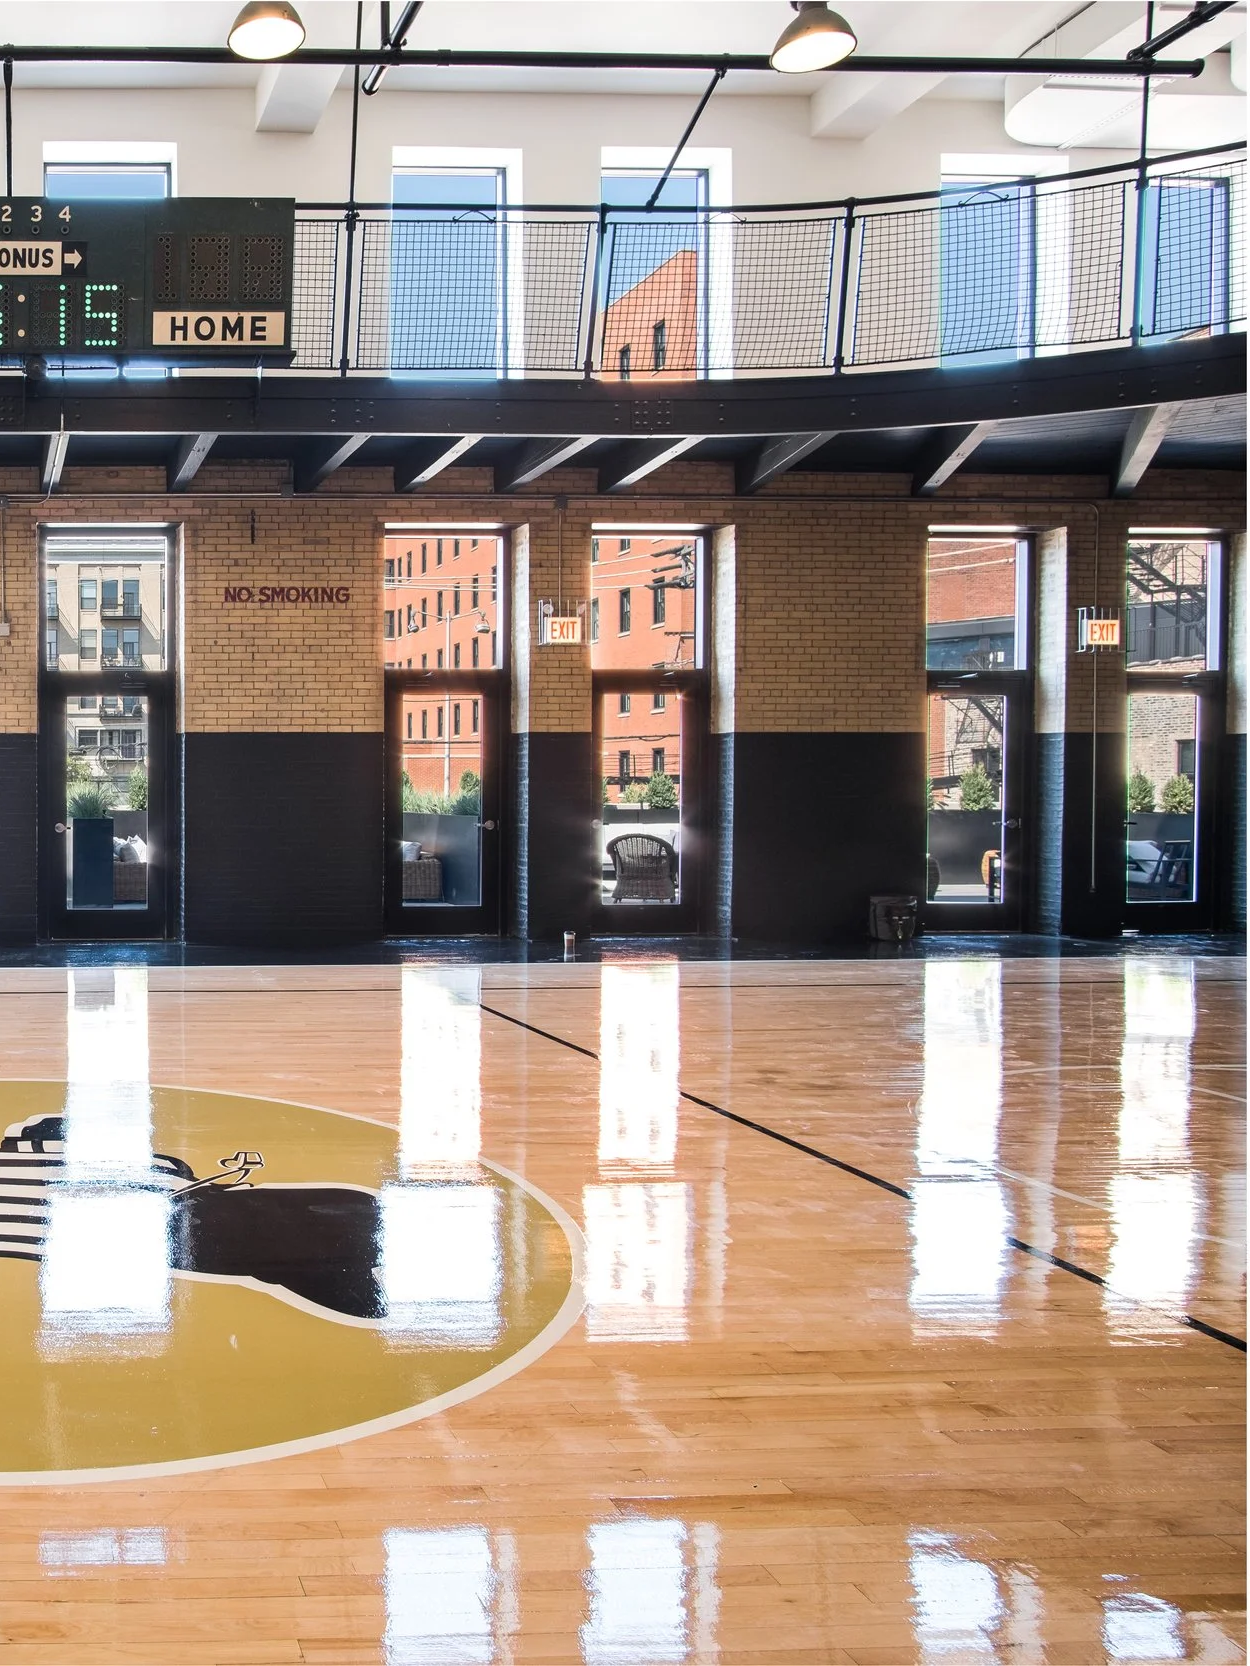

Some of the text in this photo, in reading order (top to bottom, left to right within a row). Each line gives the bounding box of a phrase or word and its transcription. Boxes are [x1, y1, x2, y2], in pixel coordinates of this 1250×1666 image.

[1, 205, 12, 222] 2
[30, 205, 42, 222] 3
[58, 205, 72, 222] 4
[170, 316, 268, 342] HOME
[224, 586, 350, 603] NO SMOKING
[551, 621, 577, 639] EXIT
[1090, 623, 1116, 641] EXIT
